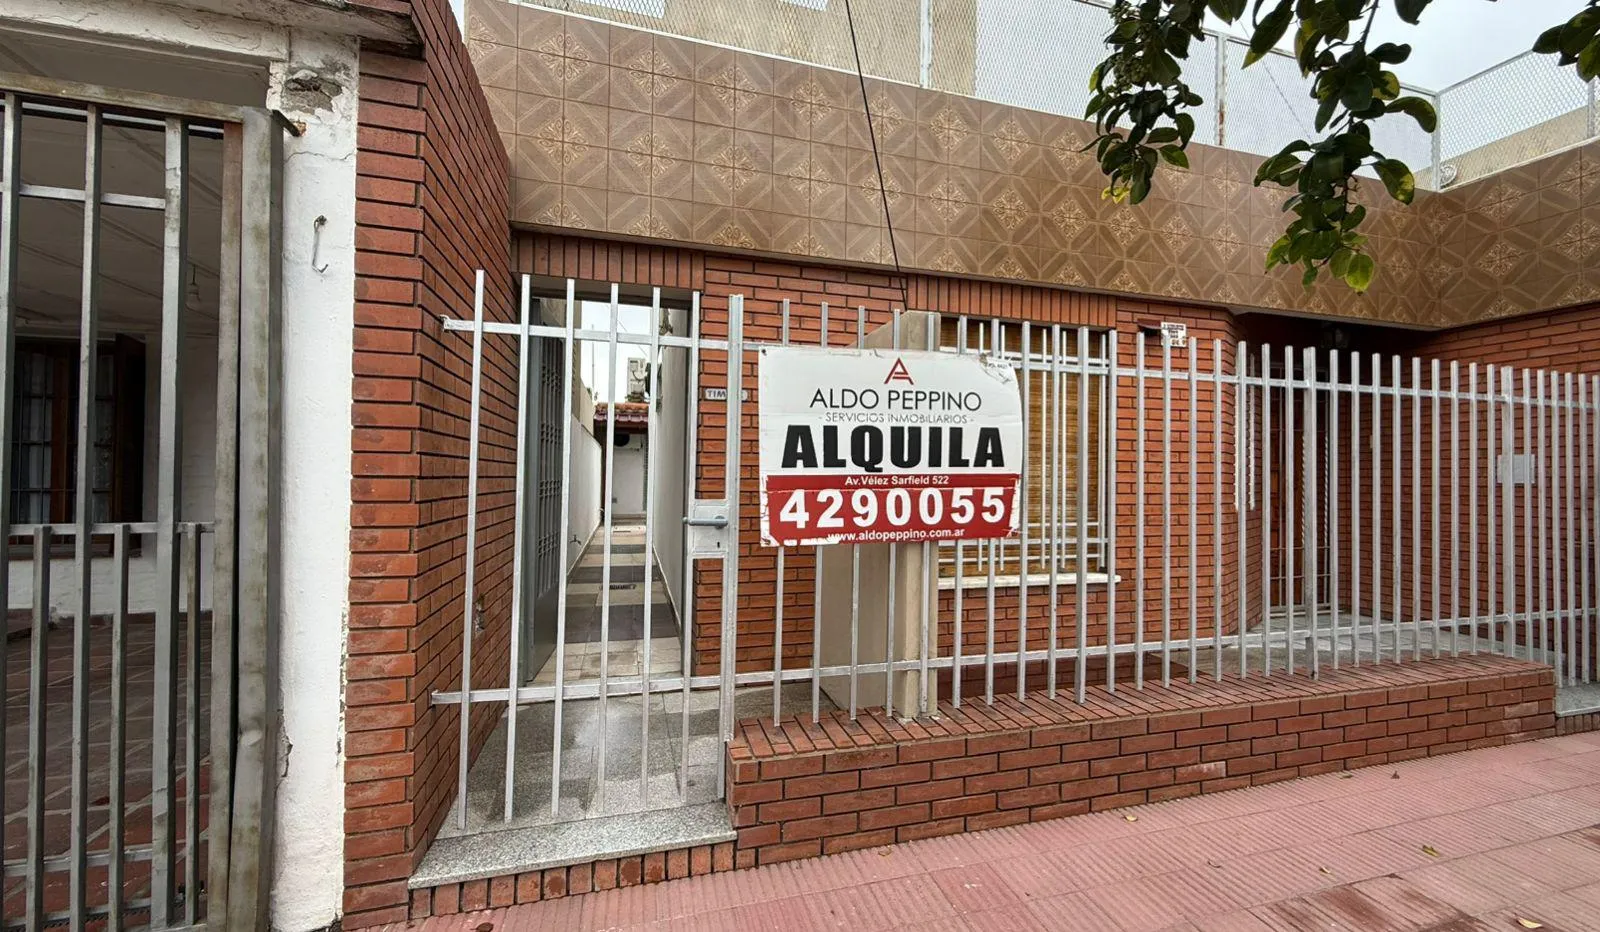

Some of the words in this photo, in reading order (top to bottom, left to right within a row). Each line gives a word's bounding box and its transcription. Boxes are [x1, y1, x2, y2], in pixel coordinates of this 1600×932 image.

[809, 388, 879, 410] ALDO
[887, 390, 982, 411] PEPPINO
[825, 411, 885, 423] SERVICIOS
[781, 424, 1005, 473] ALQUILA
[891, 475, 930, 485] Sarfield
[932, 475, 950, 485] 522
[779, 487, 1005, 529] 4290055
